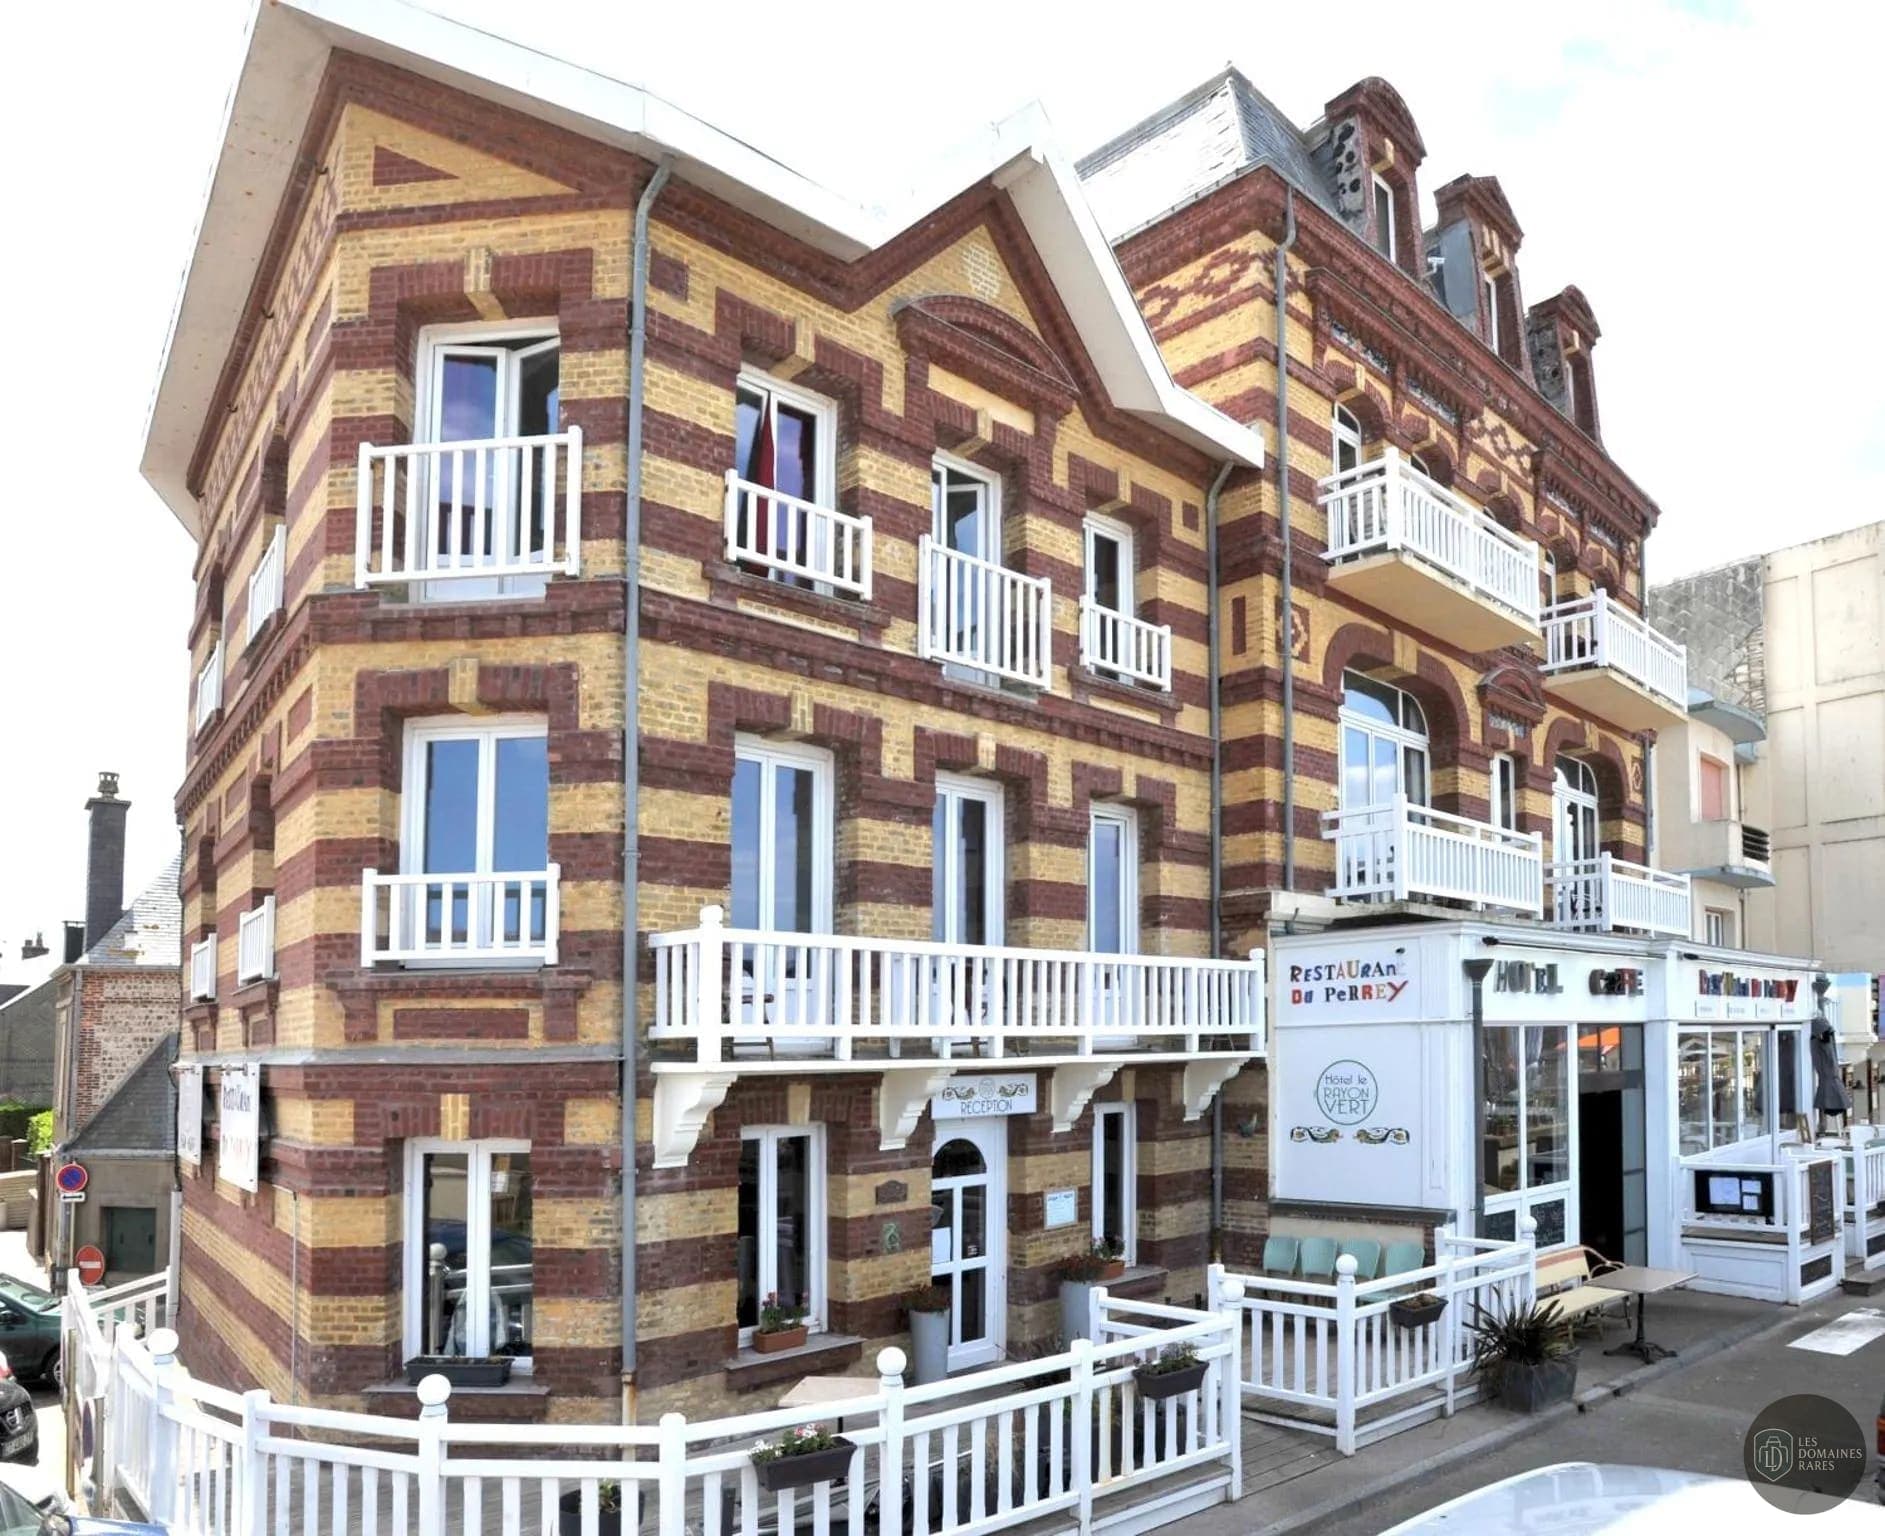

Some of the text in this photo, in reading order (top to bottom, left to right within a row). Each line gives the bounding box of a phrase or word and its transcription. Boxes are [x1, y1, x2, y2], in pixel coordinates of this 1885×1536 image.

[1358, 1074, 1368, 1085] le
[1324, 1087, 1369, 1099] RAYON
[960, 1099, 1013, 1115] RECEPTION
[1324, 1099, 1369, 1115] VERT
